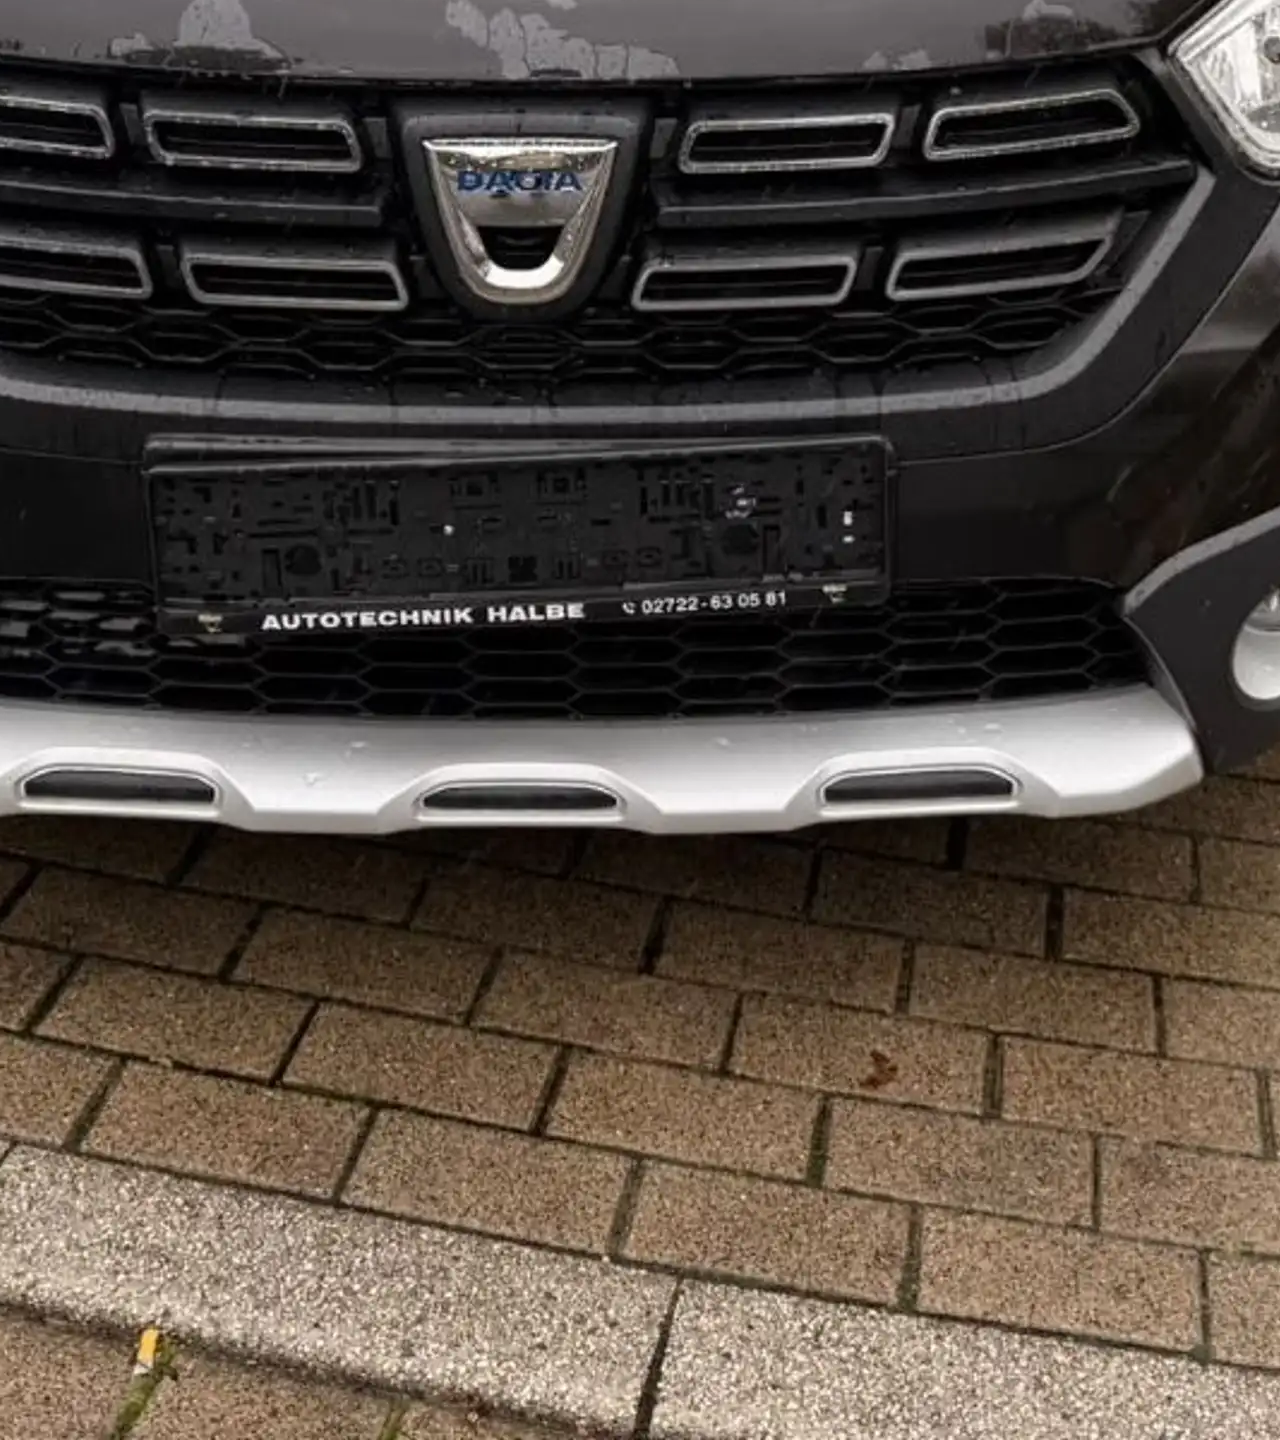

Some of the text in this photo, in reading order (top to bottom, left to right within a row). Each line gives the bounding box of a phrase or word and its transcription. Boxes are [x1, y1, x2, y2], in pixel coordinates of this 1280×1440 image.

[457, 170, 582, 191] DACIA
[738, 592, 761, 608] 05
[261, 602, 585, 630] AUTOTECHNIK HALBE
